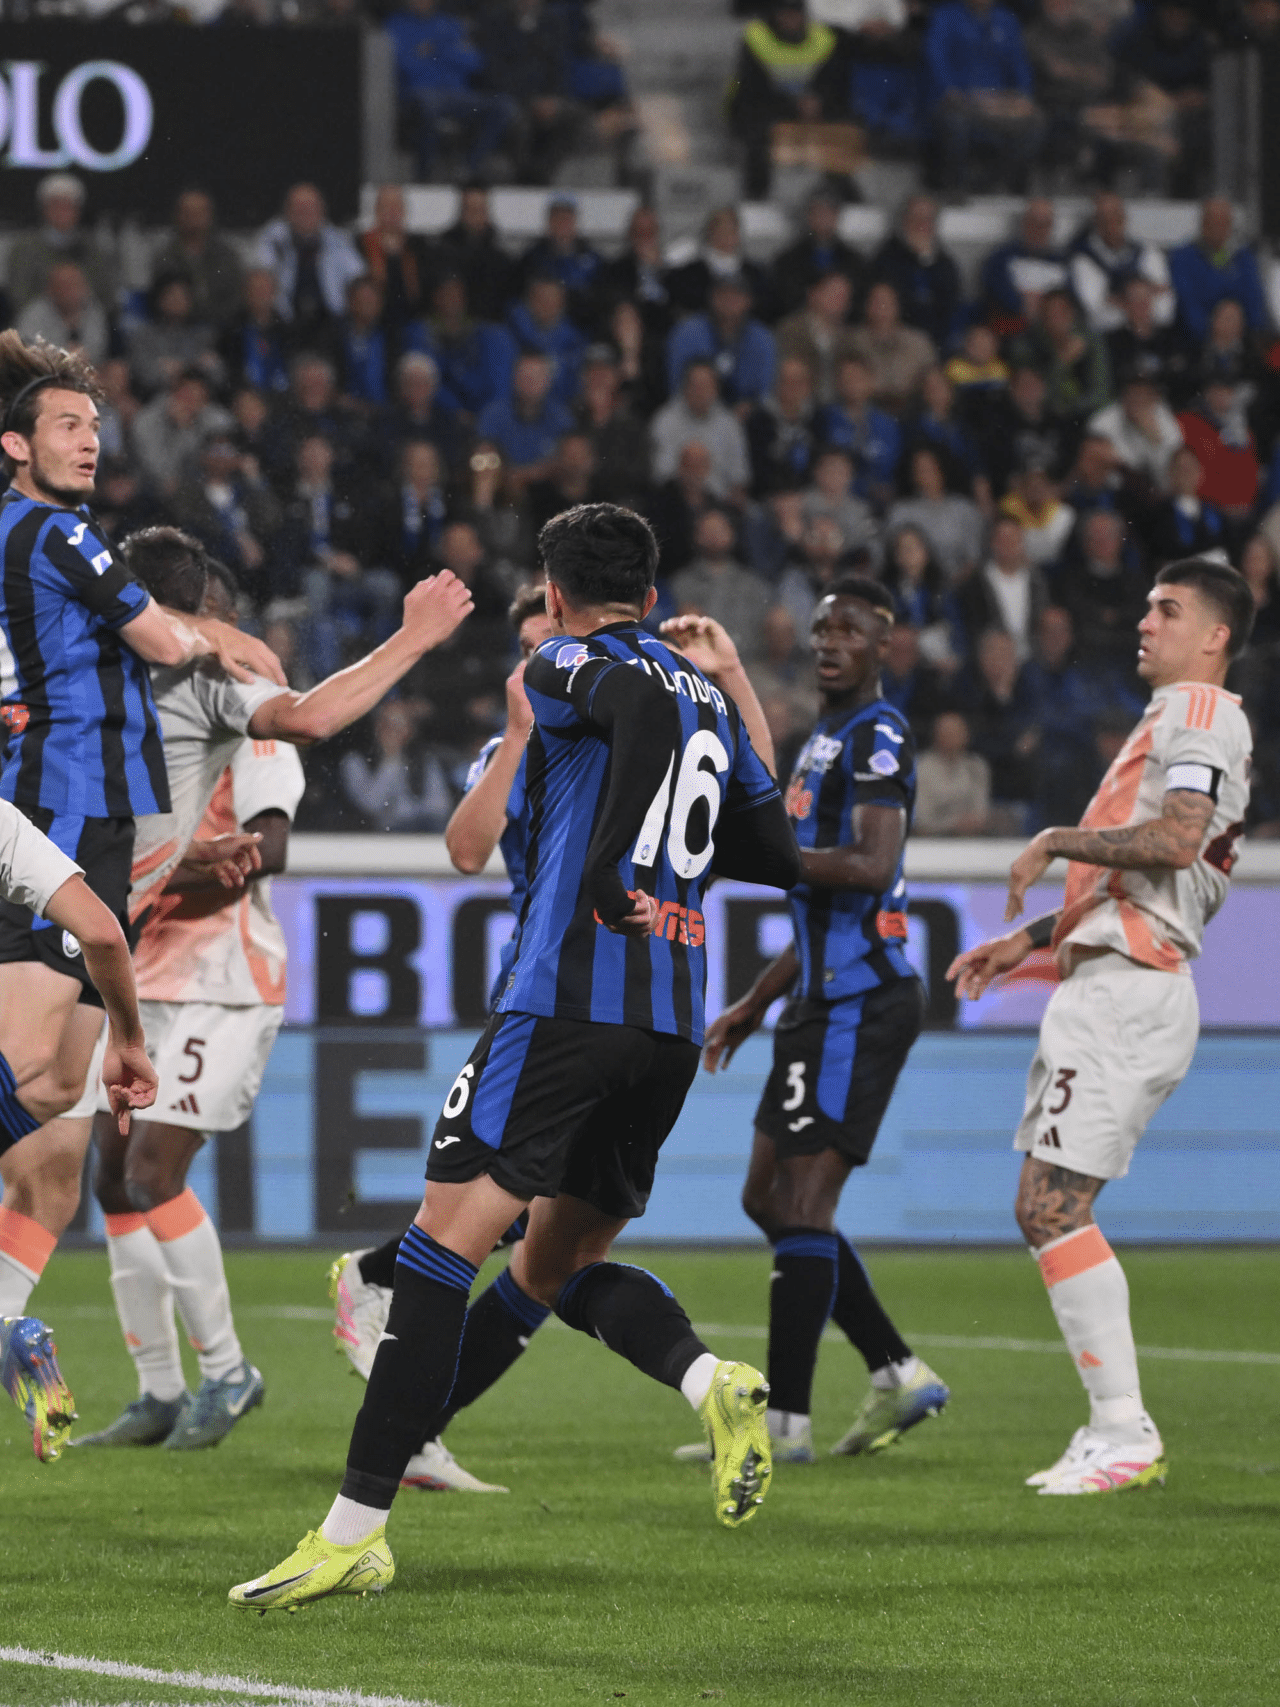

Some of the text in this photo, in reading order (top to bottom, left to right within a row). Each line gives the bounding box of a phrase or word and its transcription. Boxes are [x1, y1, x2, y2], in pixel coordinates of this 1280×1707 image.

[178, 1038, 206, 1083] 5
[442, 1064, 475, 1118] 6
[1048, 1068, 1078, 1115] 3
